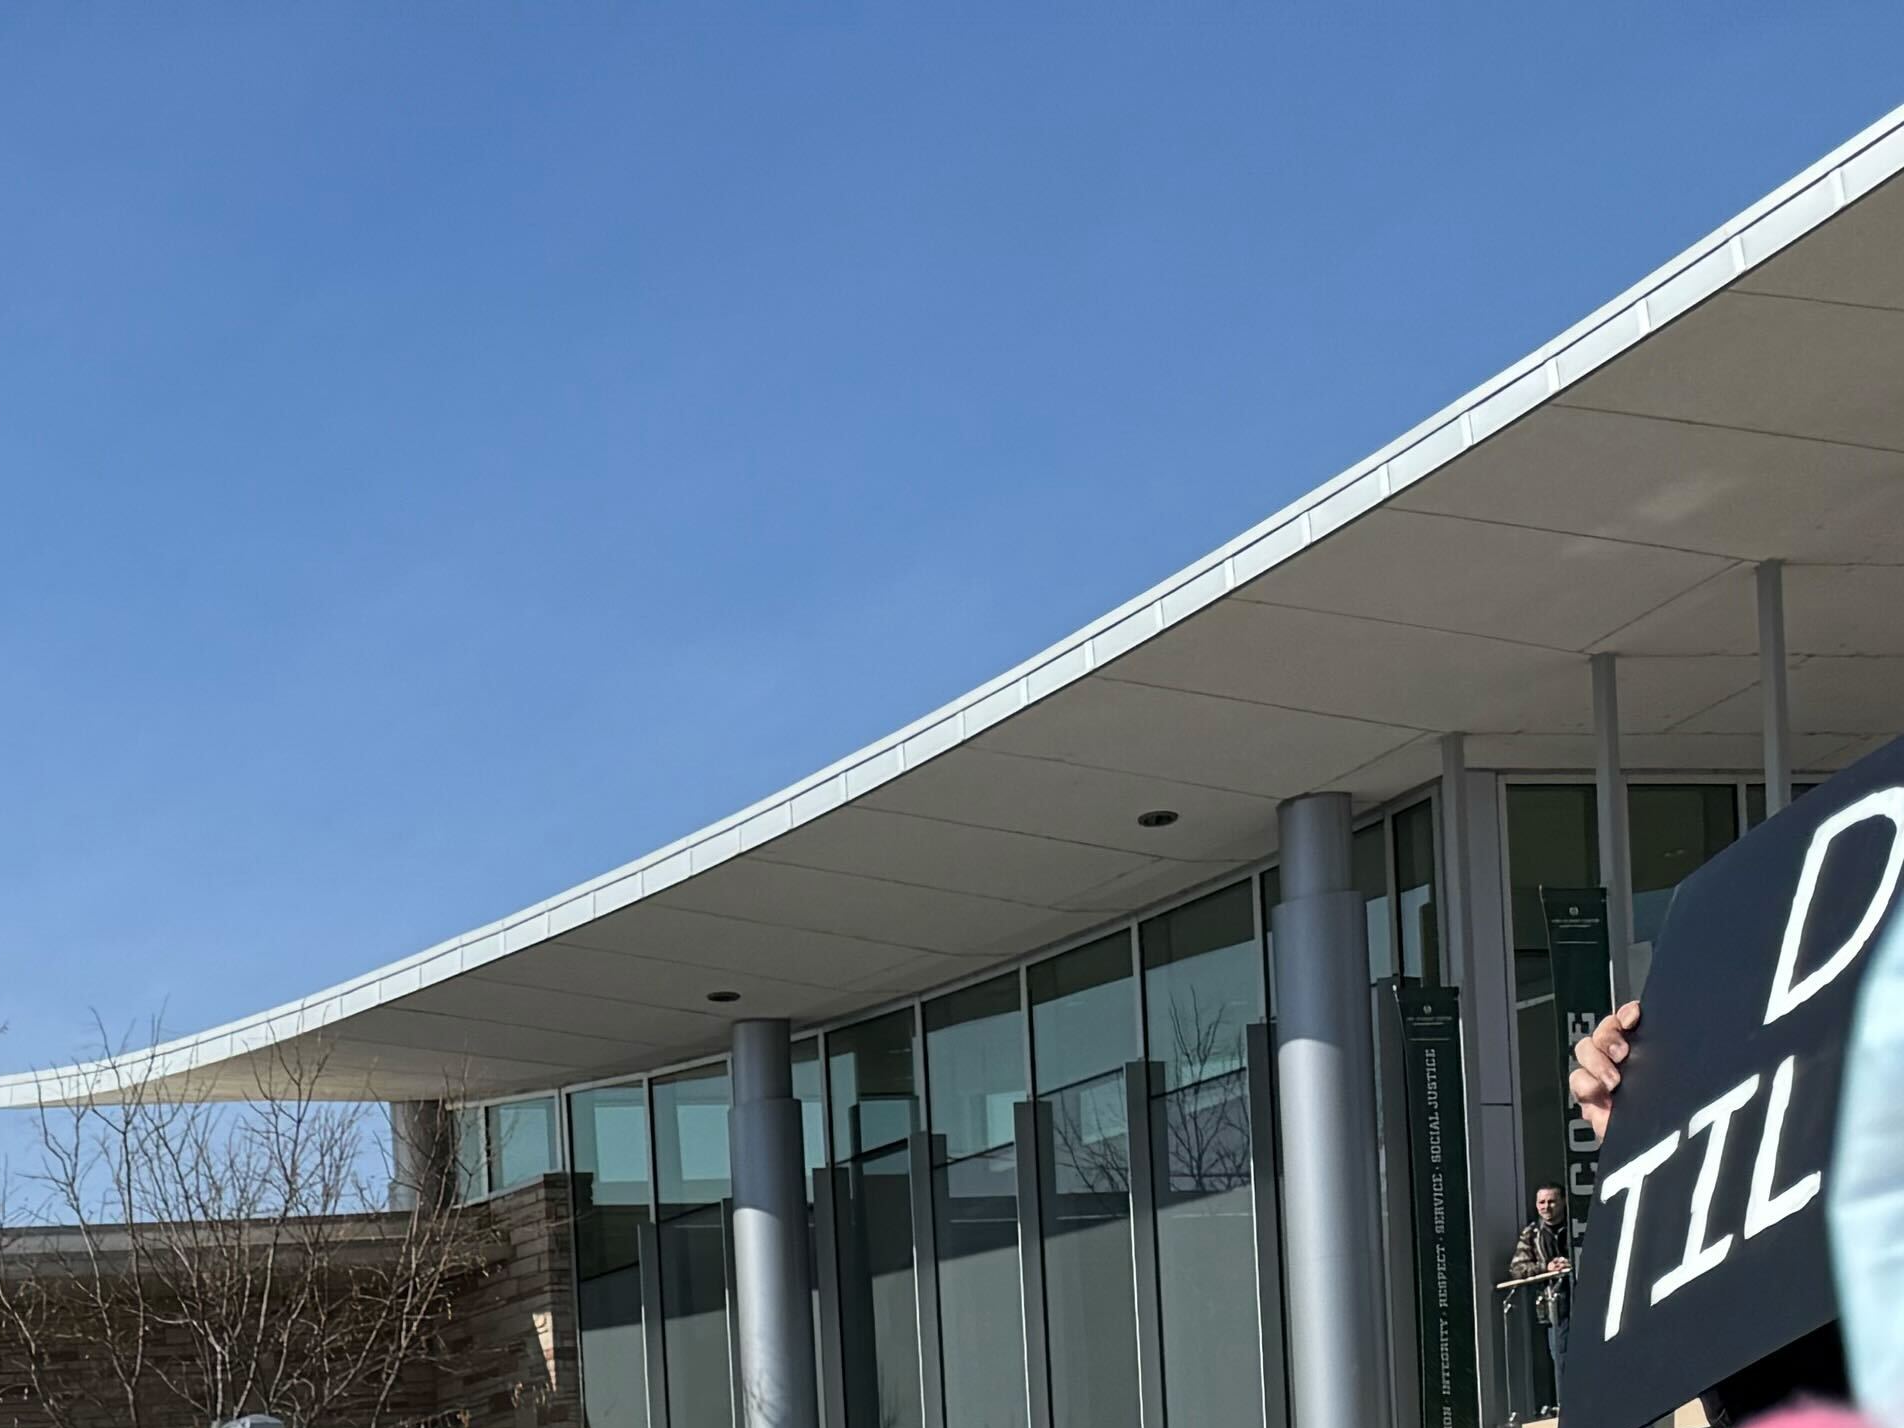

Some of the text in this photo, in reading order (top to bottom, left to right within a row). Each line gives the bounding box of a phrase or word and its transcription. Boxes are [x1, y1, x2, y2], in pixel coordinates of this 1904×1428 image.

[1764, 787, 1904, 1025] D
[1425, 1048, 1439, 1109] JUSTICE
[1429, 1112, 1442, 1163] SOCIAL
[1432, 1173, 1445, 1234] SERVICE
[1602, 1055, 1821, 1342] TIL
[1436, 1243, 1449, 1308] RESPECT
[1439, 1317, 1451, 1396] INTEGRITY
